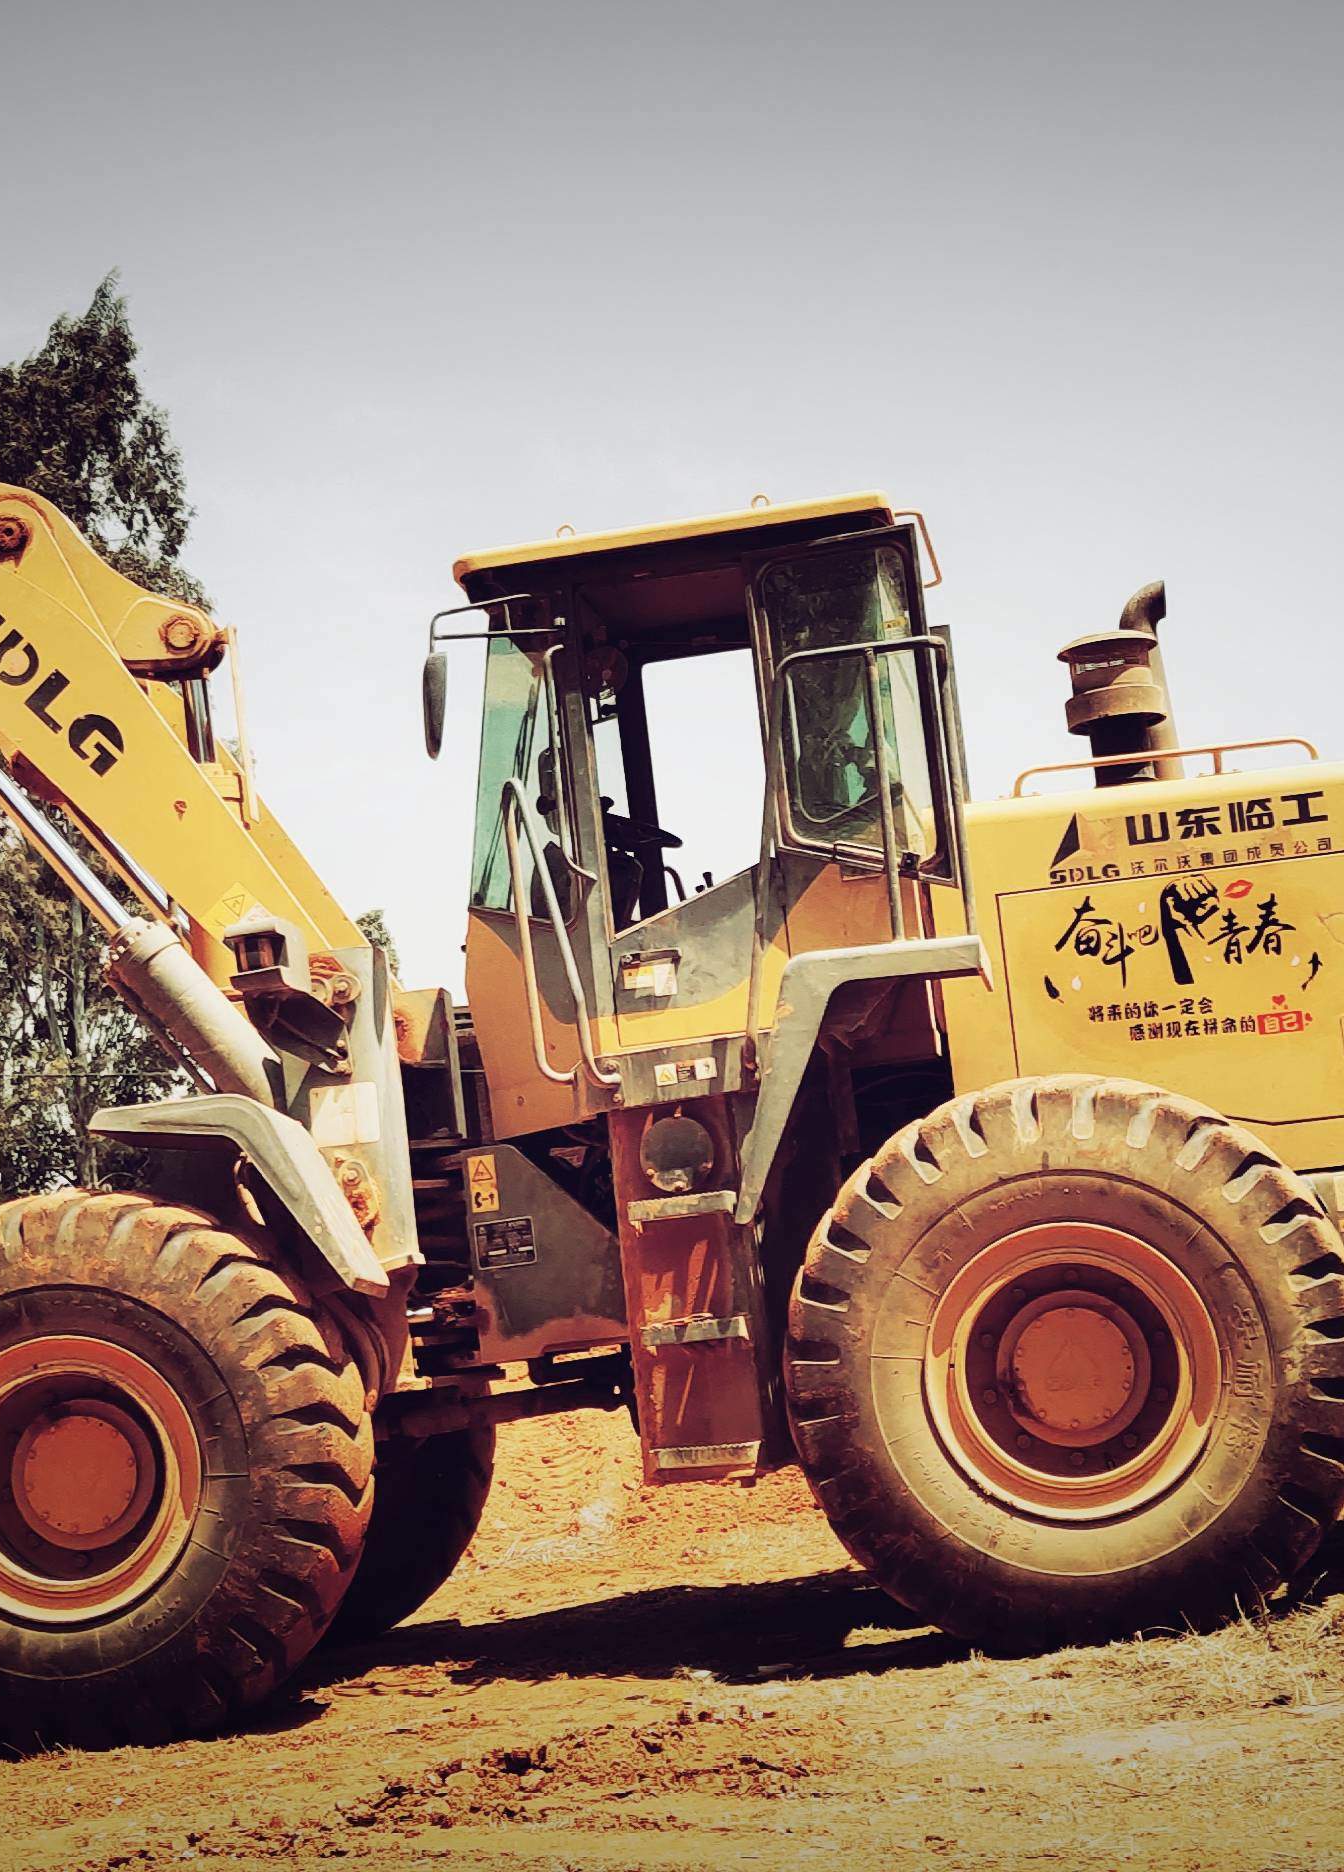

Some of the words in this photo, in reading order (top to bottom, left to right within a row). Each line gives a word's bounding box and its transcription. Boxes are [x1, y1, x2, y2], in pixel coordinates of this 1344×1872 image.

[1125, 791, 1329, 846] 山东临工
[1049, 863, 1120, 885] SDLG
[1131, 837, 1332, 875] 沃尔沃集团成员公司
[1055, 895, 1158, 988] 奋斗吧
[1208, 893, 1296, 964] 青春
[1088, 997, 1214, 1023] 将来的你一定会
